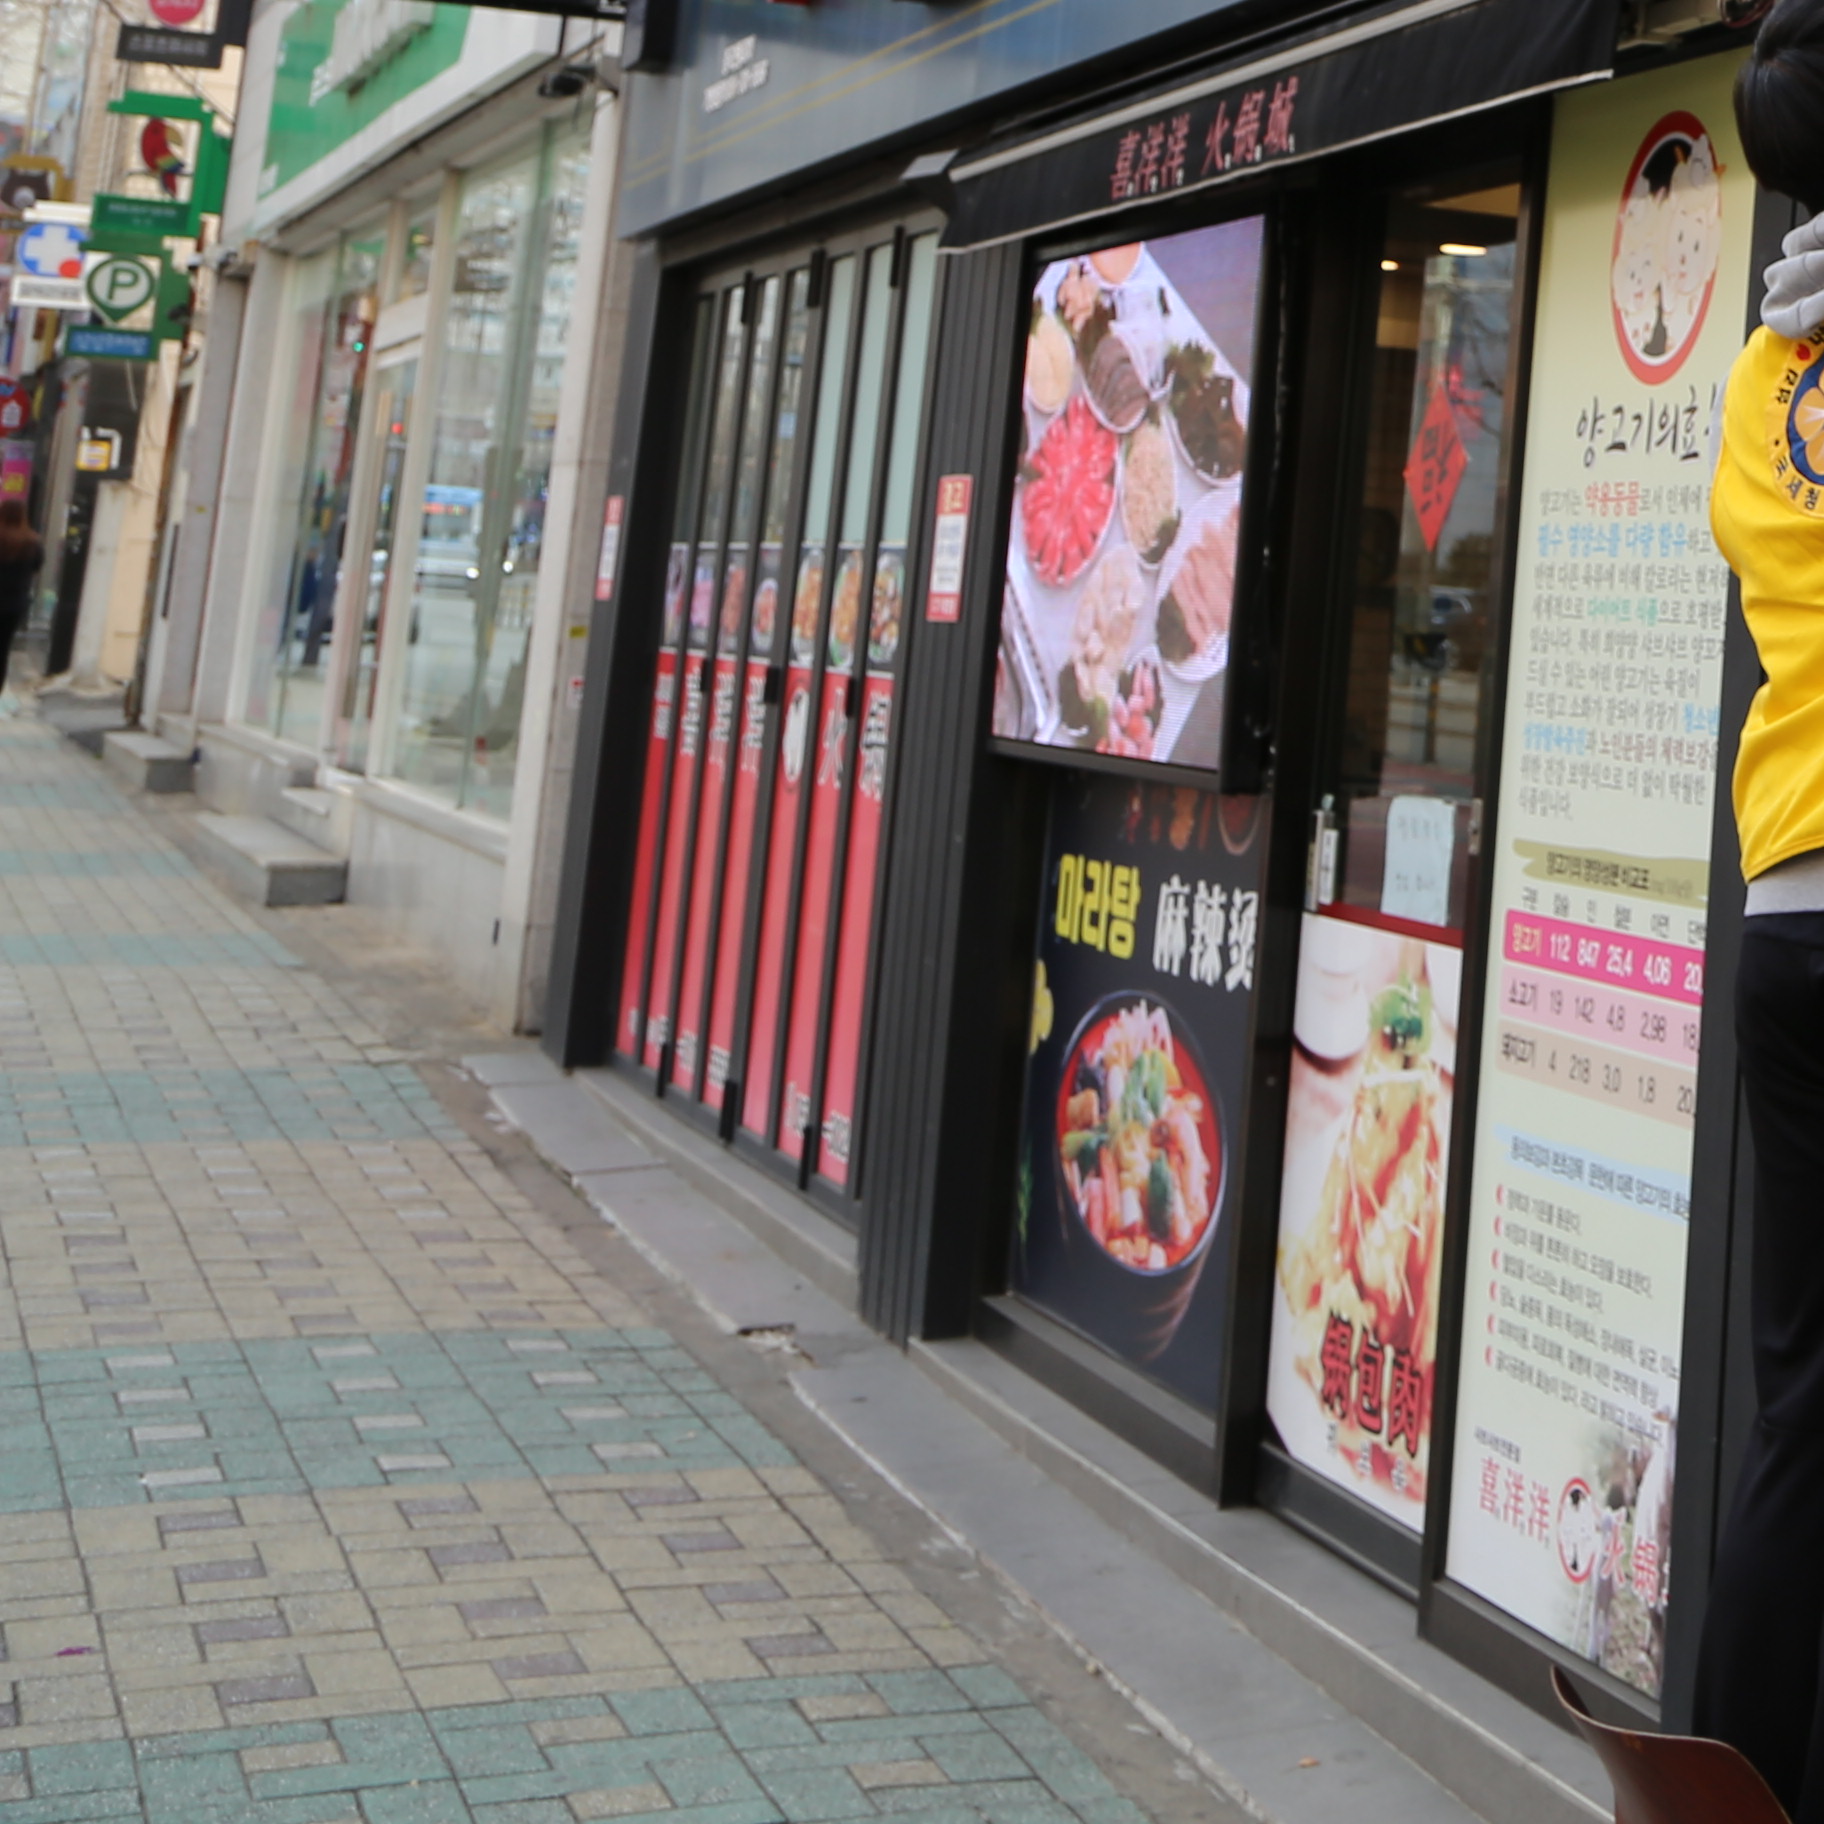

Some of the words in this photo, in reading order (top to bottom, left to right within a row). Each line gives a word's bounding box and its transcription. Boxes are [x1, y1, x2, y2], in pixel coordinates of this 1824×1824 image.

[1575, 384, 1717, 468] 양고기의효
[1055, 854, 1141, 960] 마라탕
[1549, 931, 1571, 964] 112
[1576, 936, 1601, 972] 847
